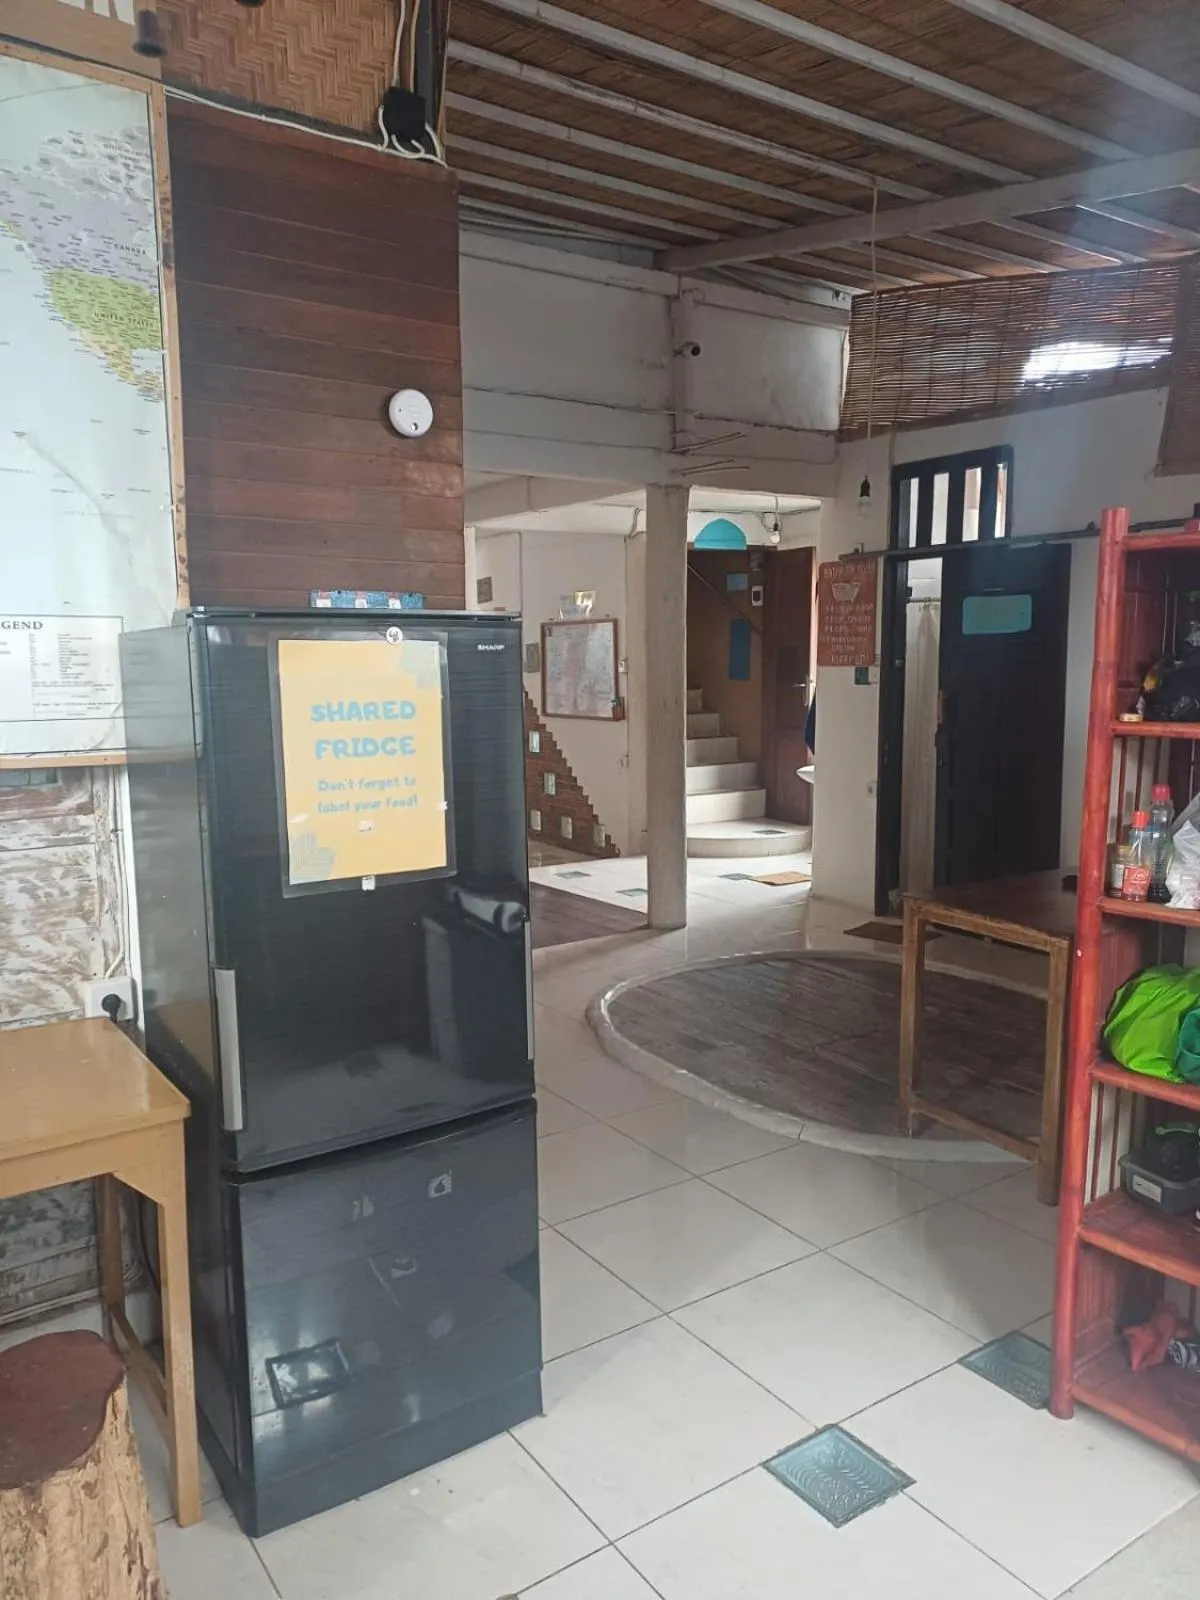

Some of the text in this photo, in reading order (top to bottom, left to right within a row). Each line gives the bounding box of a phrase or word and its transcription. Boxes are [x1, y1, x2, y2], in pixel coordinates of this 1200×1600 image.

[0, 620, 43, 630] GEND
[310, 700, 416, 722] SHARED
[315, 736, 416, 760] FRIDGE
[318, 776, 416, 791] Don't forget to
[318, 795, 418, 814] label your food!
